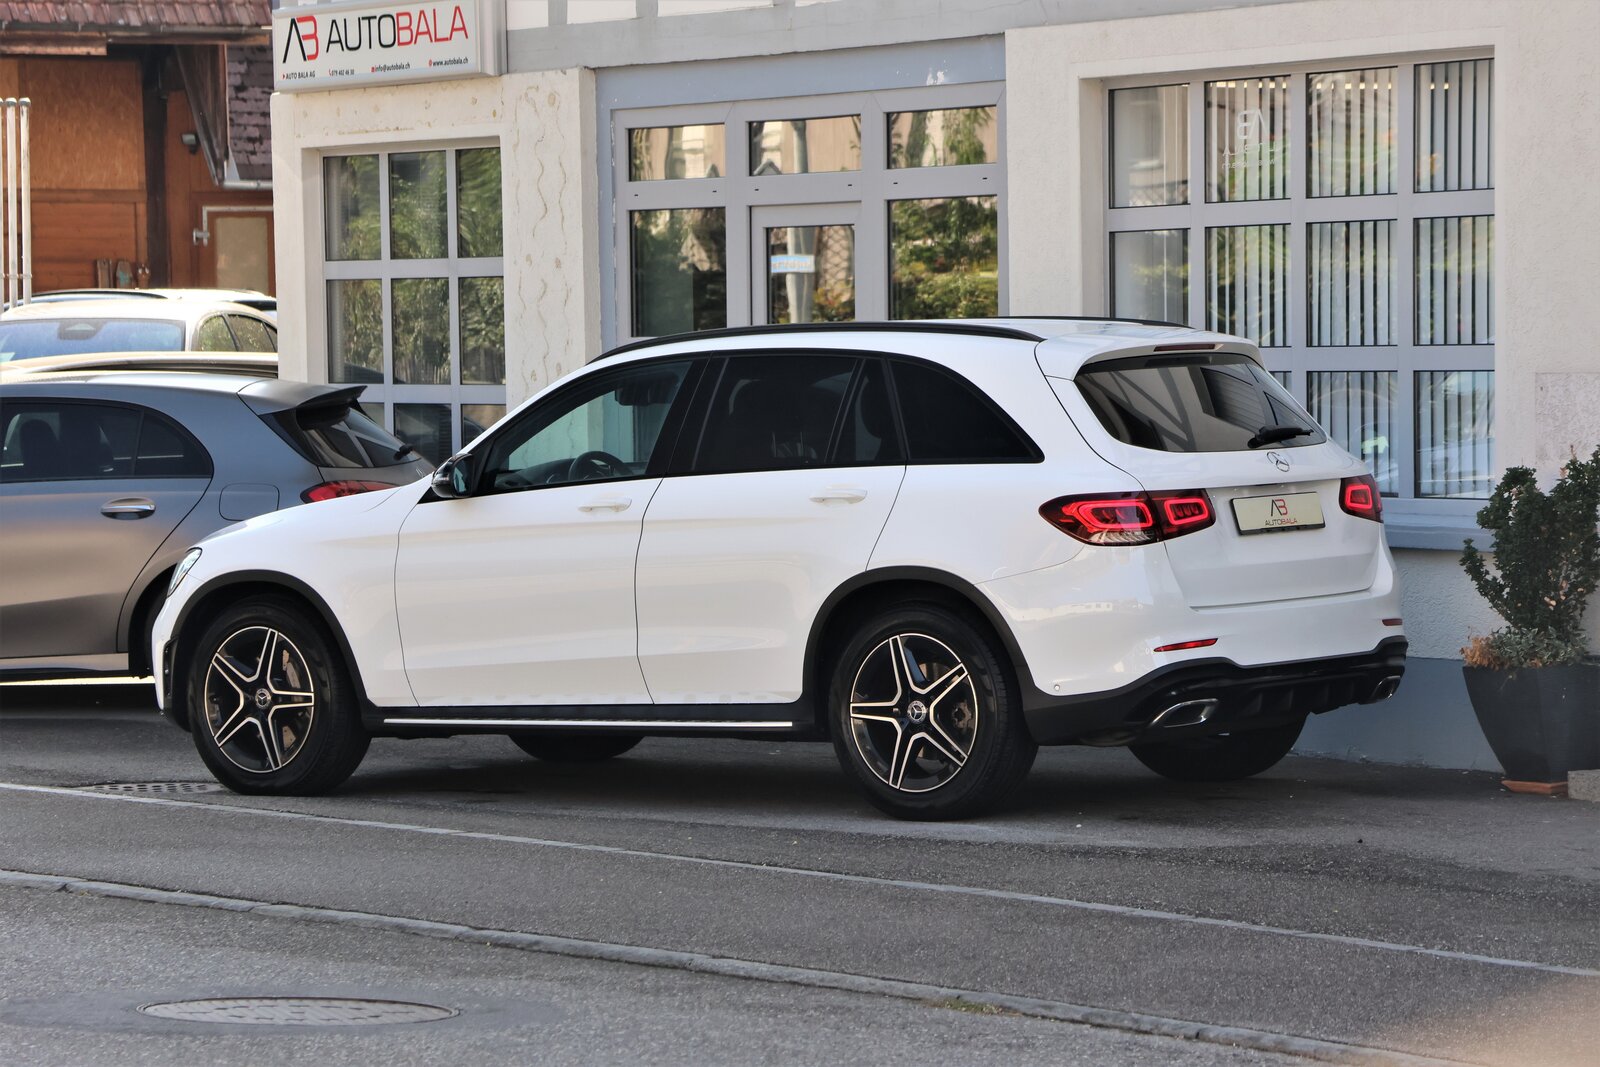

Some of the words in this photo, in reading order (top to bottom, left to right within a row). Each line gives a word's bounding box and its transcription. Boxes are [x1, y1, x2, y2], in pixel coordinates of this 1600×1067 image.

[326, 6, 469, 54] AUTOBALA
[433, 57, 469, 67] www.autobala.ch
[375, 62, 411, 73] info@autobala.ch
[286, 72, 298, 80] AUTO
[298, 71, 309, 79] BALA
[309, 70, 316, 78] AG
[1265, 517, 1297, 526] AUTOBALA
